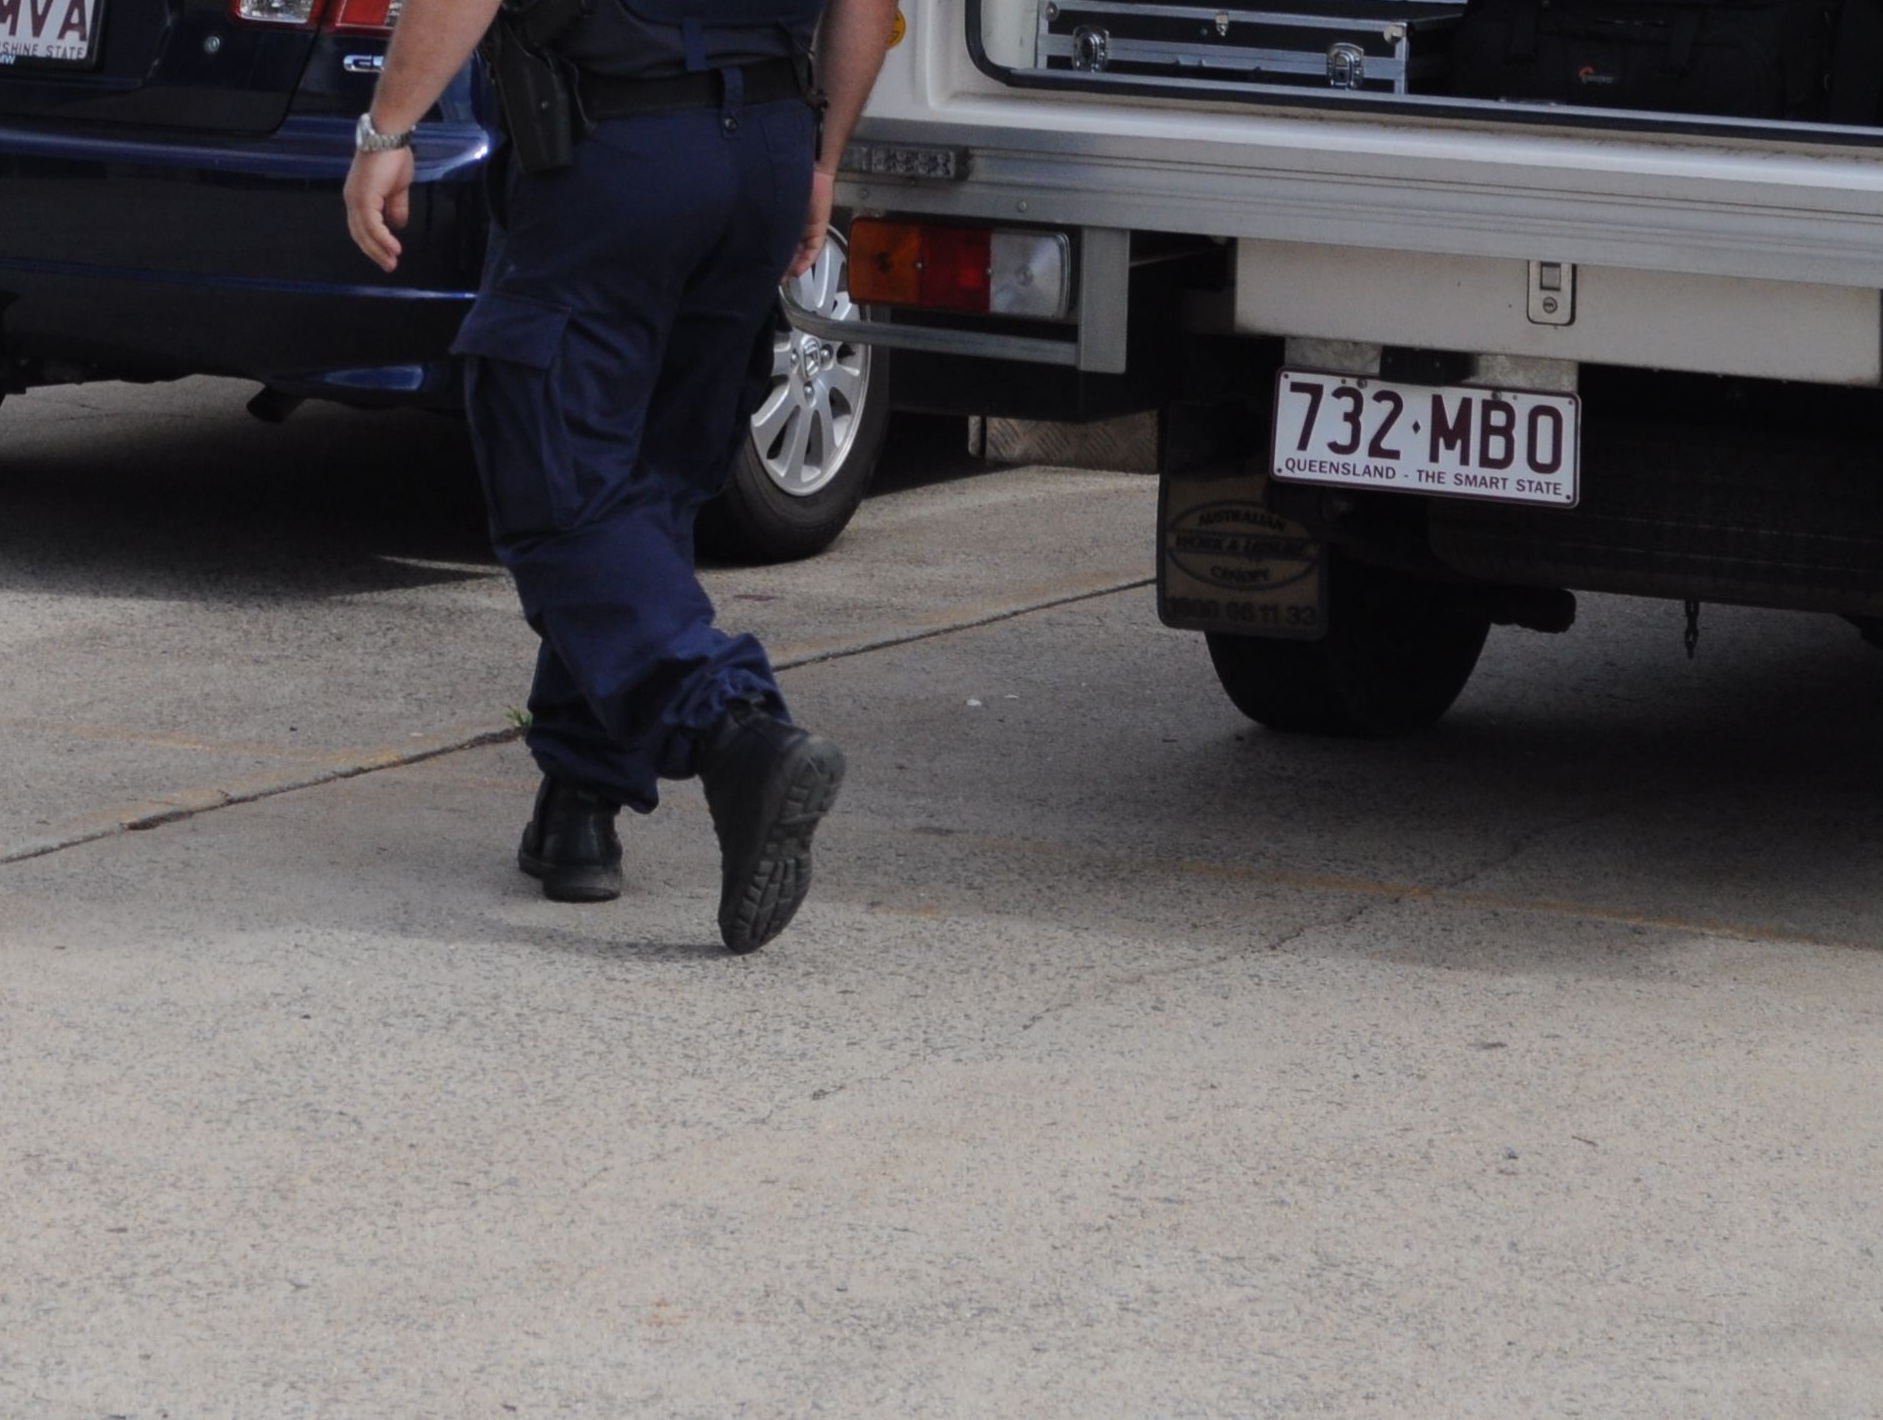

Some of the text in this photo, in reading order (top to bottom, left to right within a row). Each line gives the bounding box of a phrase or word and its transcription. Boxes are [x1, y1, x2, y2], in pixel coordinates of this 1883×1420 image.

[45, 45, 85, 60] STATE
[1284, 457, 1397, 480] QUEENSLAND
[1416, 469, 1446, 485] THE
[1453, 472, 1509, 491] SMART
[1515, 478, 1563, 496] STATE
